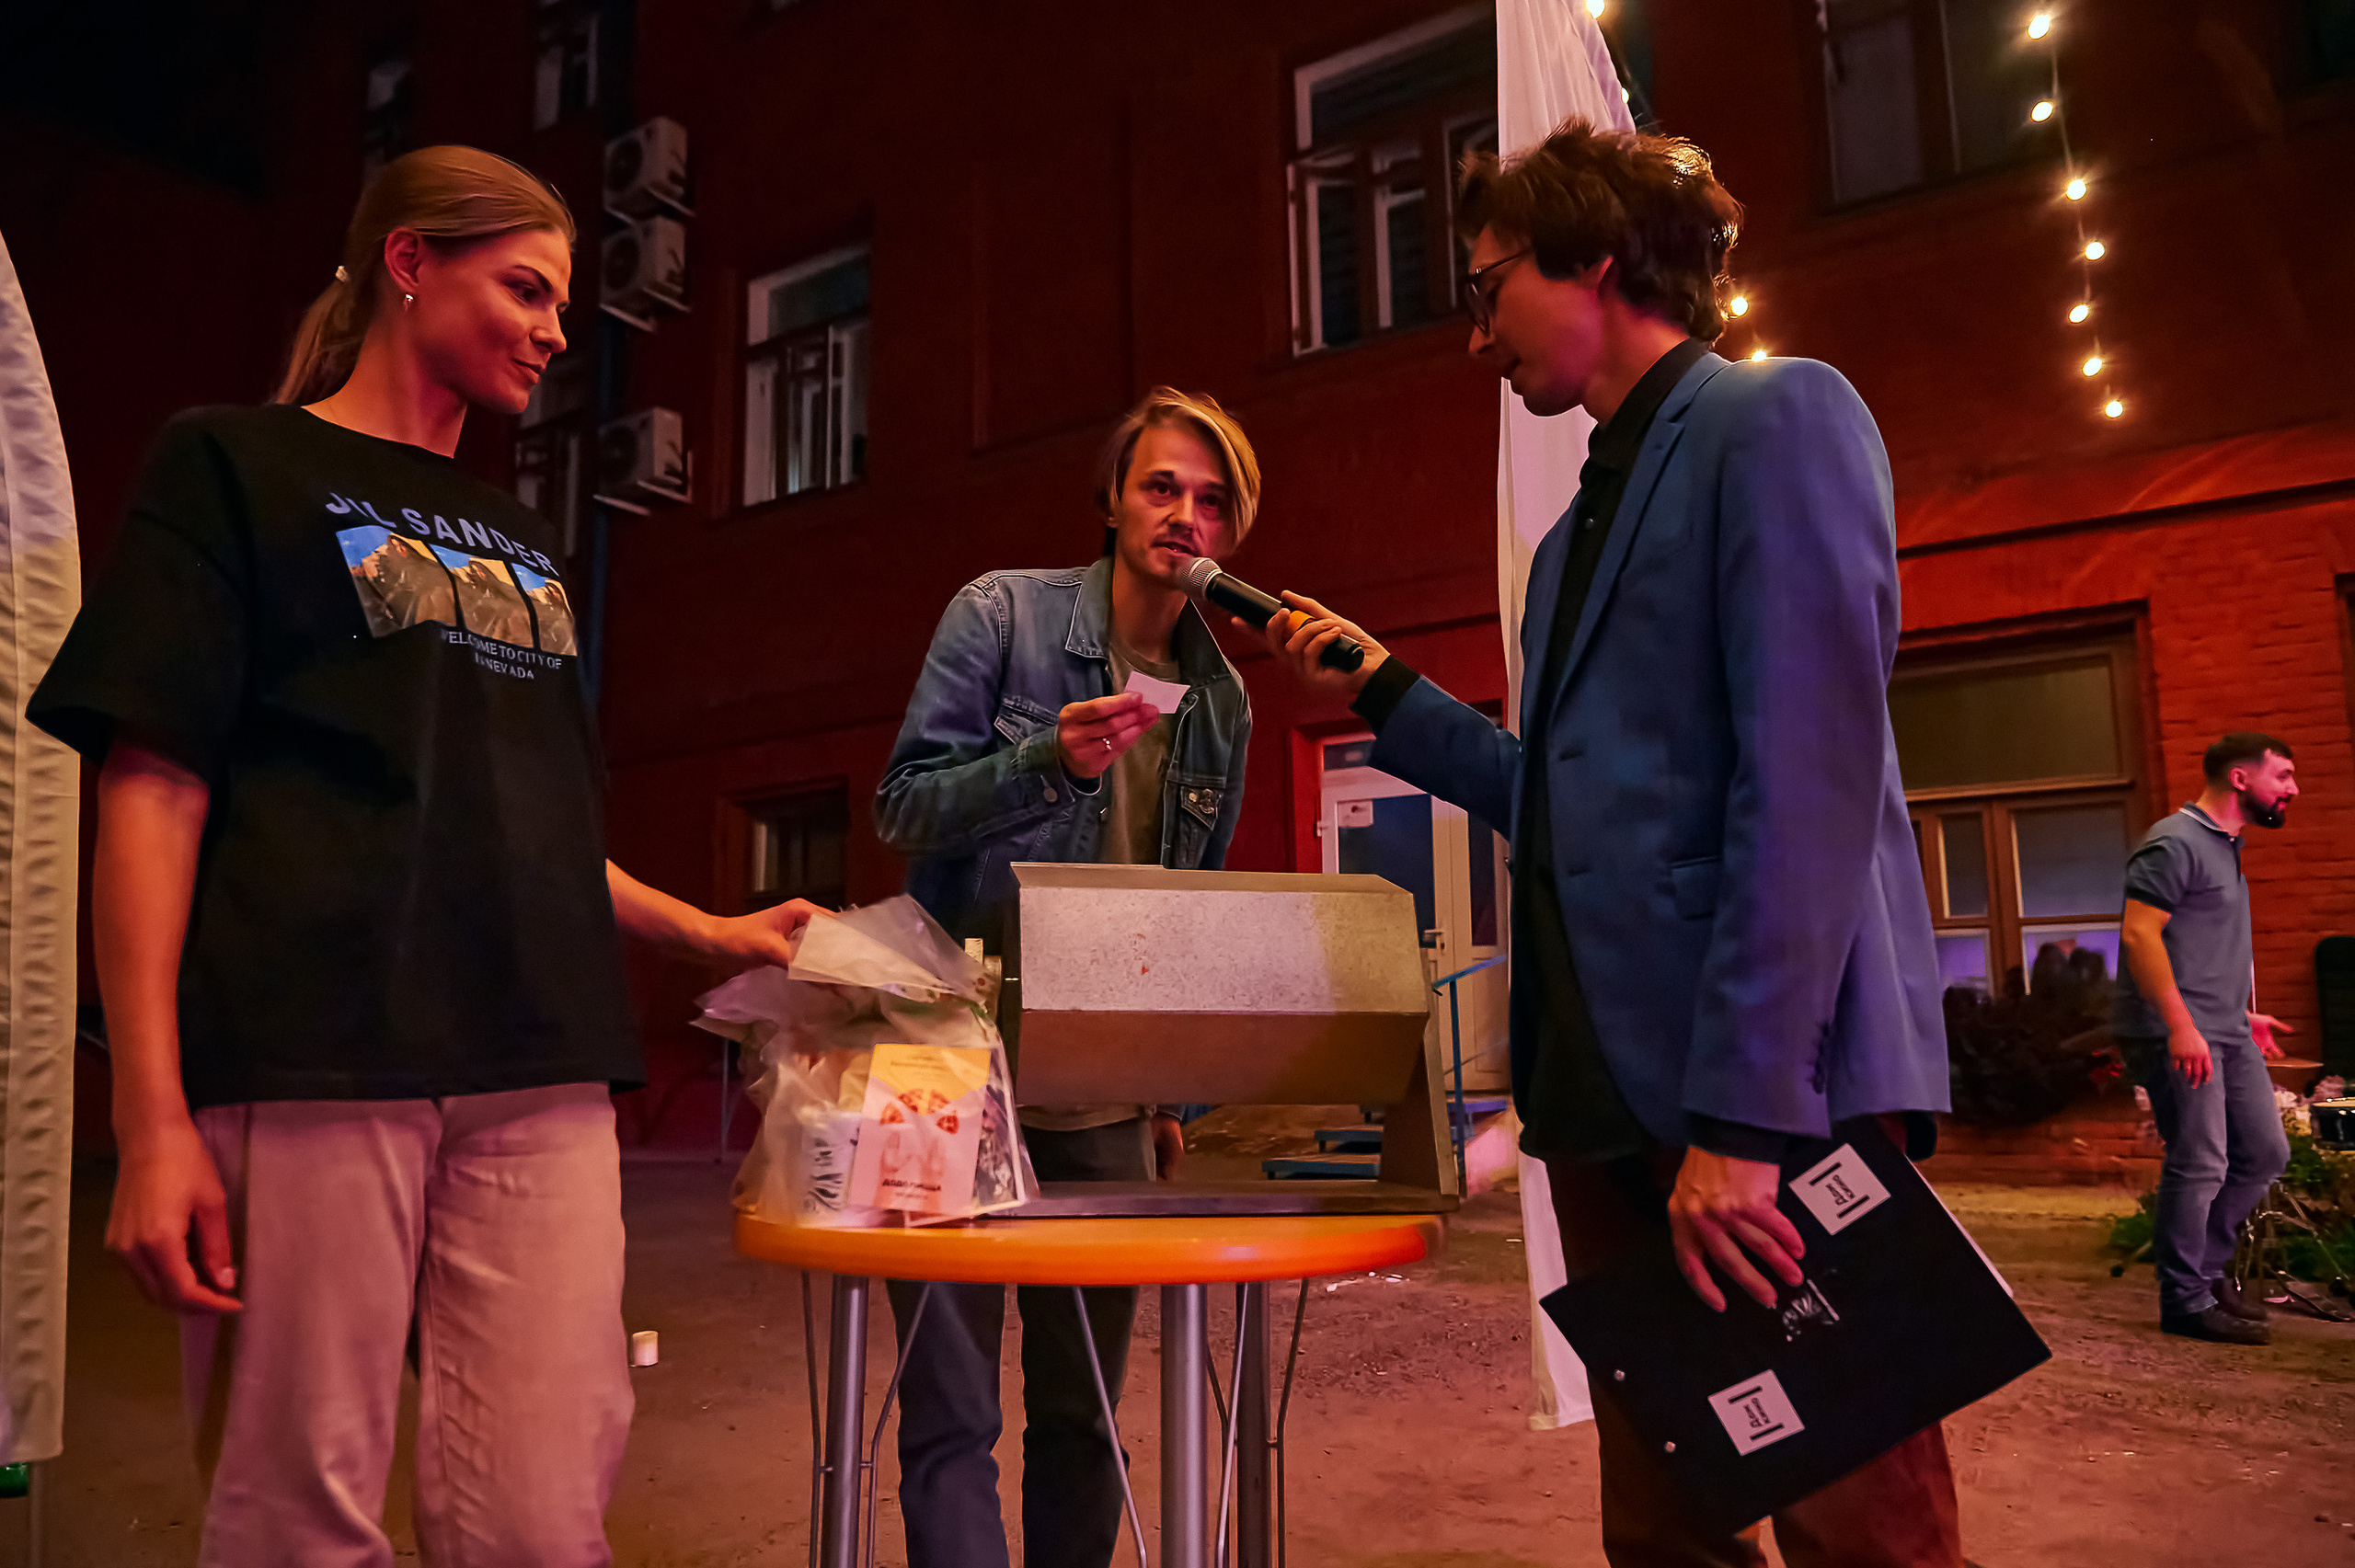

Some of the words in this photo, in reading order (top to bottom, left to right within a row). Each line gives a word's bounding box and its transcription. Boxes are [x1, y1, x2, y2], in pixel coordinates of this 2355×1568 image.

[326, 492, 396, 528] JIL
[401, 508, 559, 577] SANDER
[499, 646, 515, 659] TO
[517, 650, 545, 665] CITY
[546, 657, 562, 670] OF
